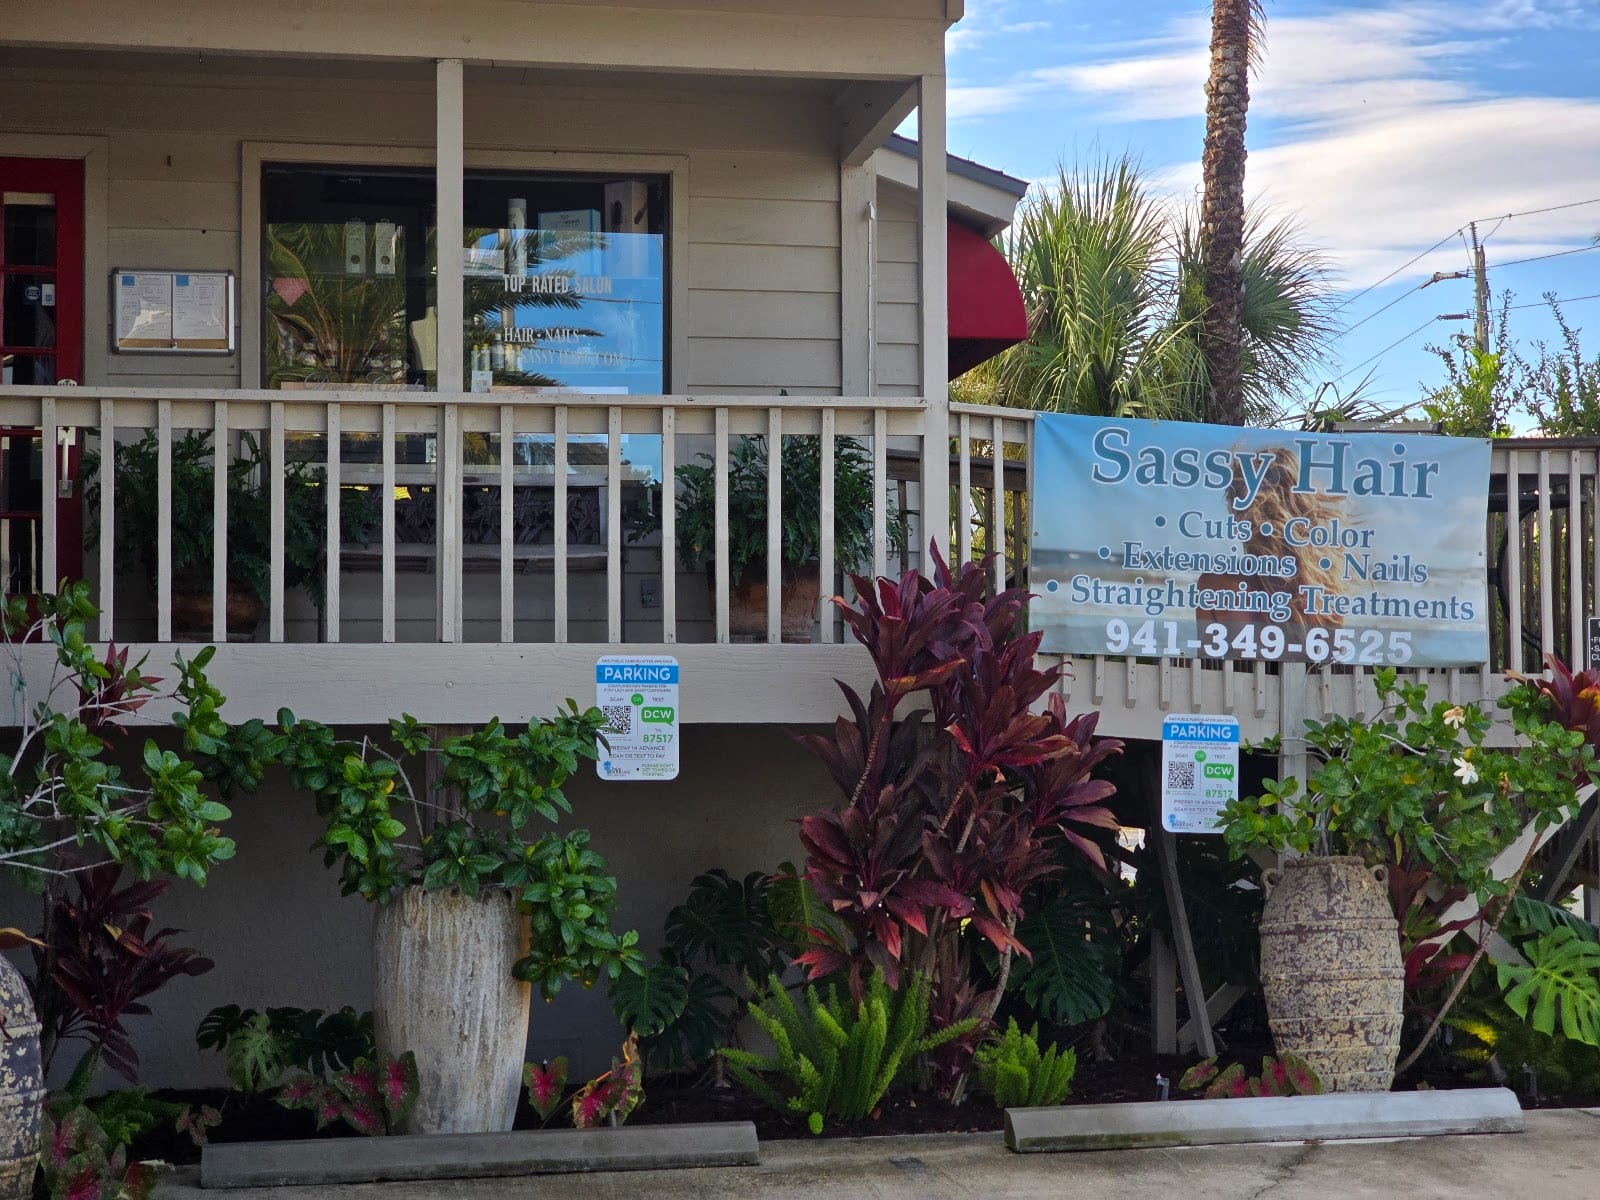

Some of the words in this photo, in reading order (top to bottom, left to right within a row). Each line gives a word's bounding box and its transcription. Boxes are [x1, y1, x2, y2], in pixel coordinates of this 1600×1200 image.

[503, 275, 525, 292] TOP
[532, 276, 569, 293] RATED
[574, 277, 612, 294] SALON
[504, 327, 534, 343] HAIR
[545, 328, 579, 343] NAILS
[1092, 426, 1276, 510] Sassy
[1291, 437, 1440, 500] Hair
[1178, 510, 1252, 541] Cuts
[1283, 517, 1375, 548] Color
[1122, 541, 1296, 577] Extensions
[1342, 552, 1428, 584] Nails
[1071, 574, 1292, 622] Straightening
[1299, 585, 1475, 621] Treatments
[1106, 618, 1412, 664] 941-349-6525
[604, 667, 671, 681] PARKING
[644, 710, 672, 719] DCW
[643, 734, 673, 743] 87517
[1170, 724, 1232, 739] PARKING
[1206, 766, 1233, 776] DCW
[1205, 789, 1233, 798] 87517
